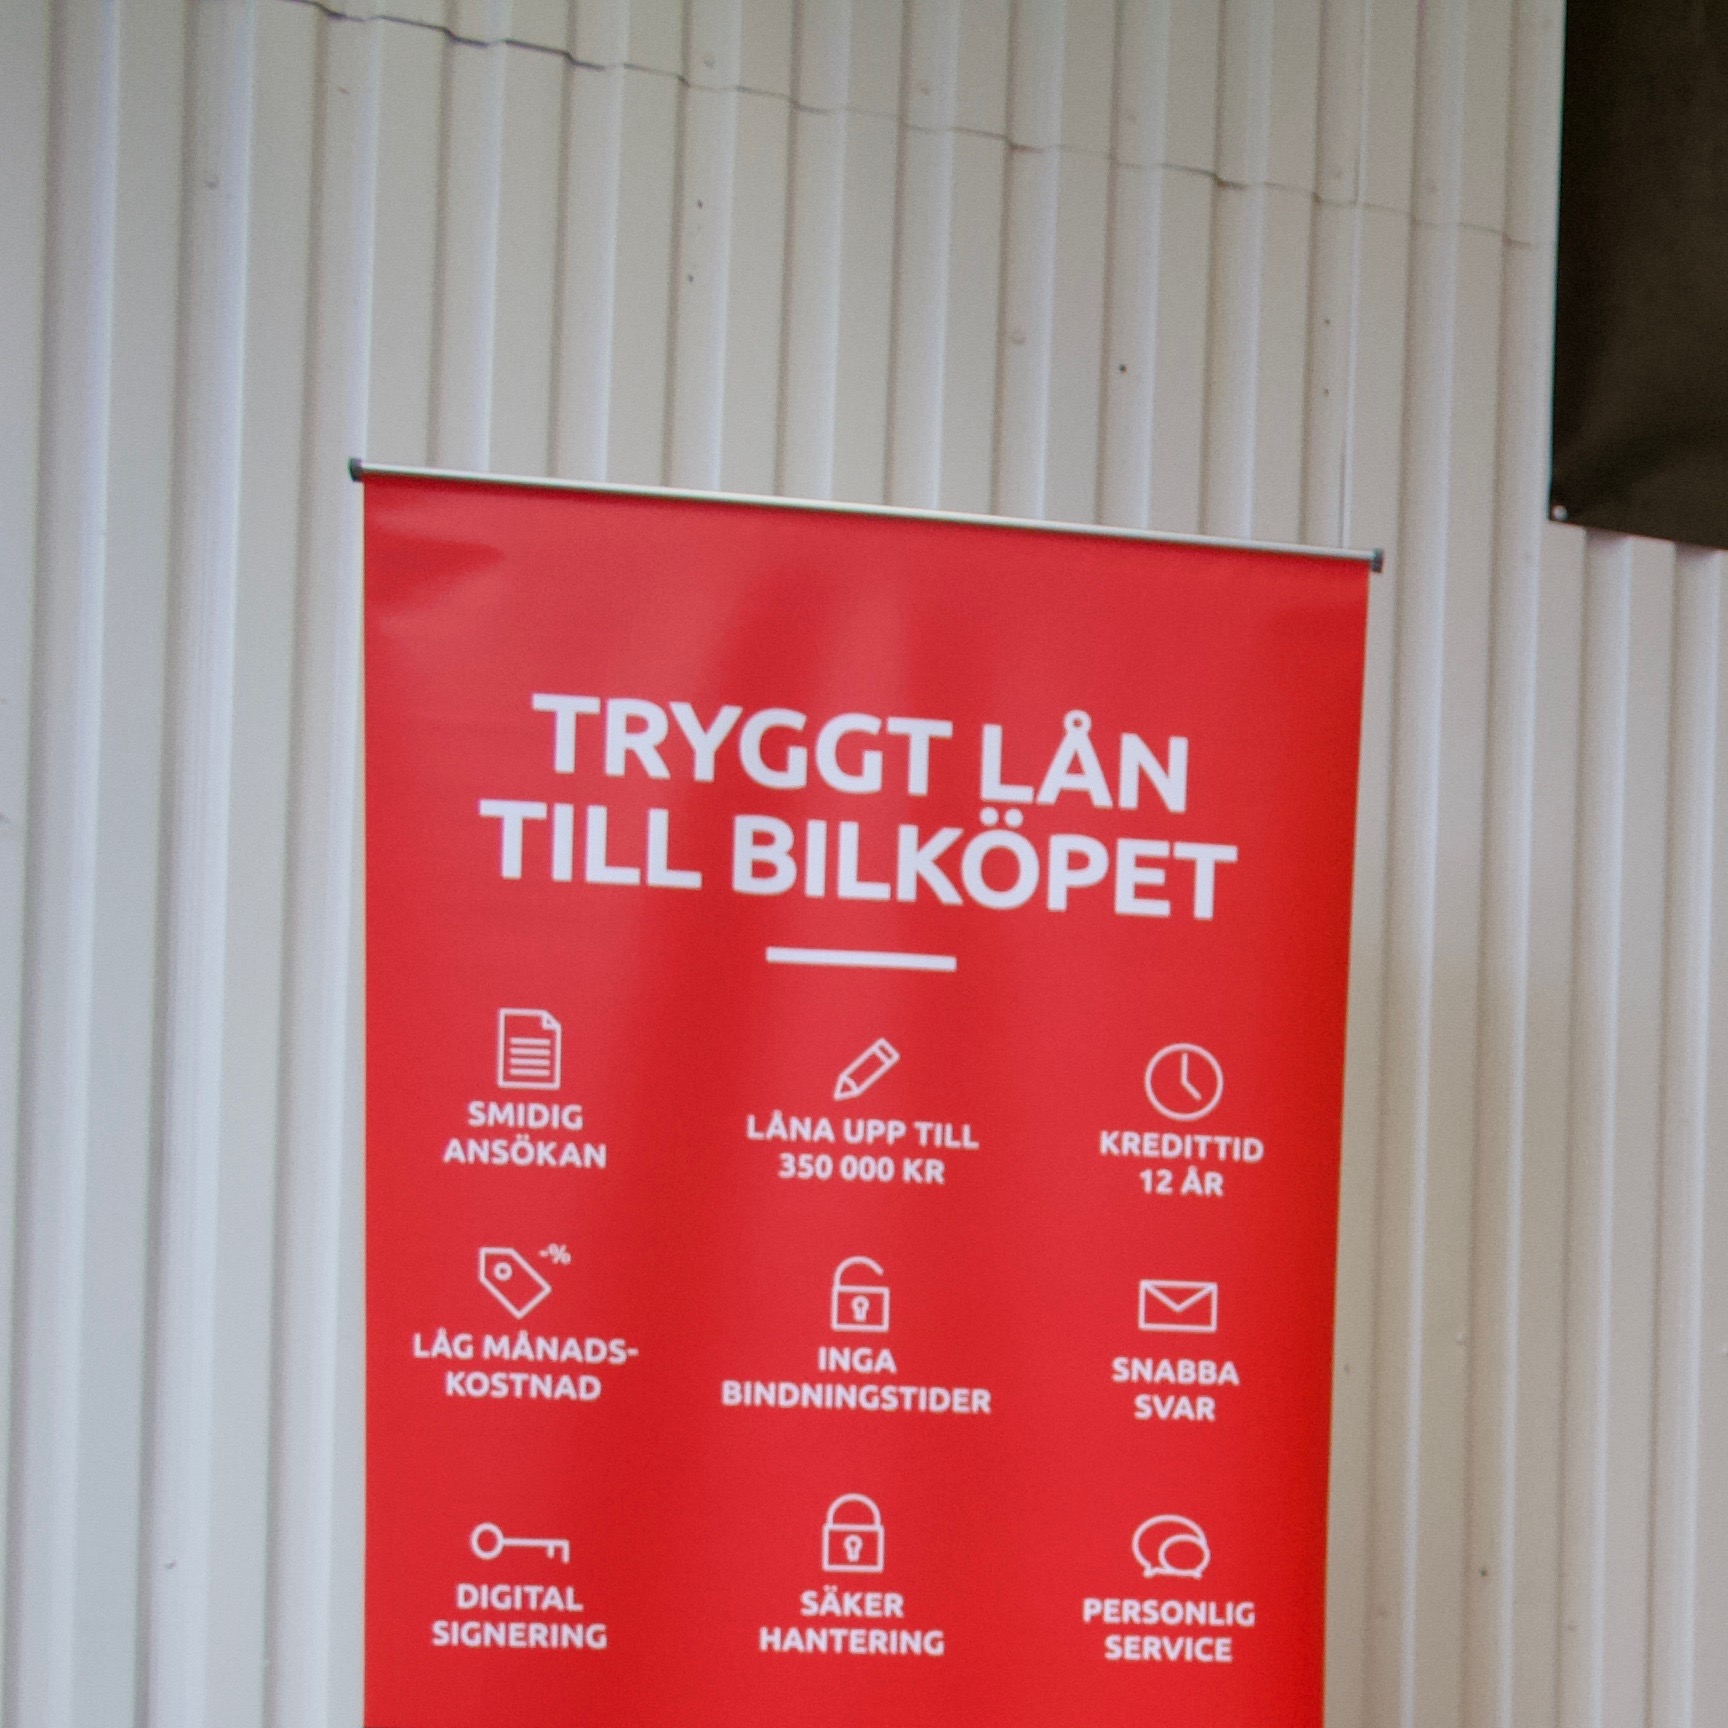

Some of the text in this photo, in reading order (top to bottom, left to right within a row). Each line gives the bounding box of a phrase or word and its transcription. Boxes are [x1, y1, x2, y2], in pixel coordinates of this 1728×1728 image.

[532, 694, 1188, 813] TRYGGT LÅN
[480, 800, 1237, 919] TILL BILKÖPET
[469, 1101, 583, 1130] SMIDIG
[747, 1110, 979, 1149] LÅNA UPP TILL
[444, 1134, 606, 1168] ANSÖKAN
[1100, 1131, 1263, 1162] KREDITTID
[779, 1153, 944, 1184] 350 000 KR
[1140, 1165, 1223, 1196] 12 ÅR
[414, 1328, 638, 1364] LÅG MÅNADS-
[819, 1347, 896, 1373] INGA
[446, 1371, 601, 1400] KOSTNAD
[1112, 1357, 1239, 1385] SNABBA
[722, 1380, 990, 1413] BINDNINGSTIDER
[1135, 1394, 1215, 1421] SVAR
[457, 1583, 583, 1611] DIGITAL
[801, 1585, 903, 1617] SÄKER
[1083, 1598, 1255, 1626] PERSONLIG
[432, 1620, 607, 1649] SIGNERING
[760, 1627, 944, 1655] HANTERING
[1105, 1635, 1232, 1662] SERVICE
